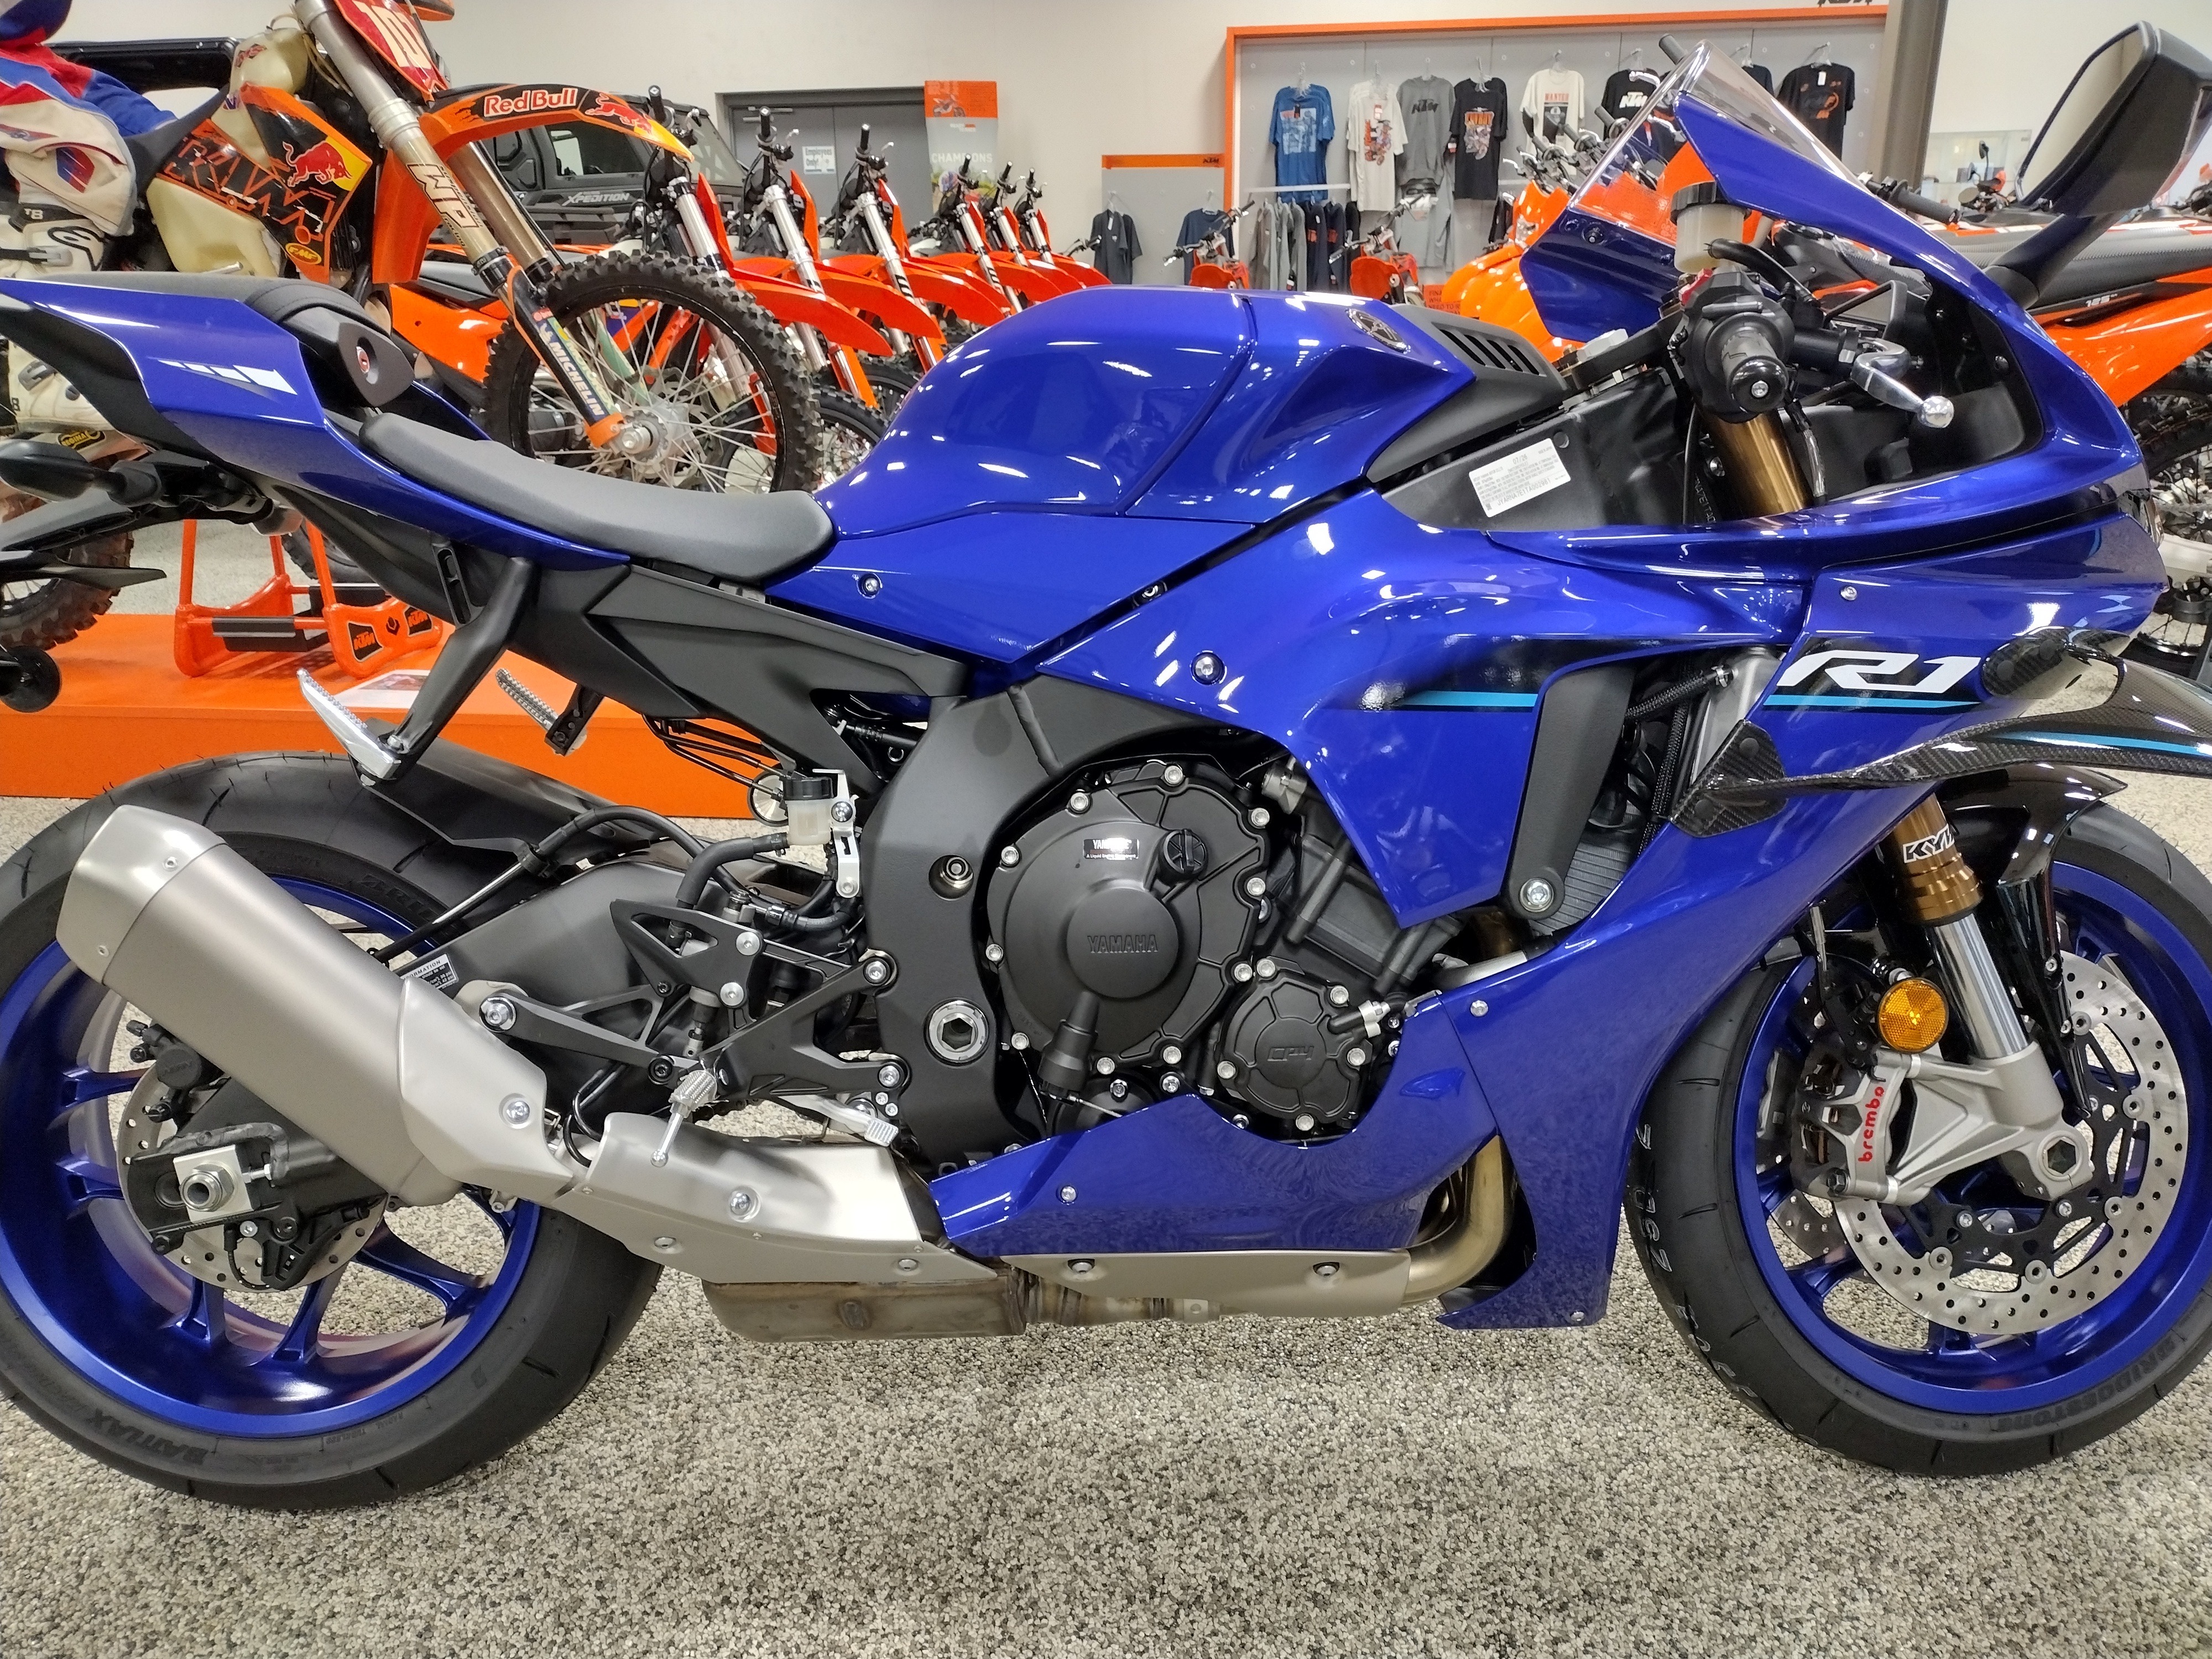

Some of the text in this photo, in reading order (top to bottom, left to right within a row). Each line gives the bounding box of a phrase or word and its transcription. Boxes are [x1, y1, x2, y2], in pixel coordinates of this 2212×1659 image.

[484, 87, 578, 117] Red Bull
[1411, 98, 1439, 114] KTM
[1619, 91, 1648, 108] KTM
[406, 164, 480, 229] WP
[561, 191, 630, 206] XPEDITION
[444, 218, 466, 247] racing
[287, 247, 319, 262] FMF
[549, 341, 605, 416] MICHELIN
[408, 610, 429, 628] KTM
[353, 630, 376, 650] KTM
[1776, 649, 1981, 693] R1
[1087, 934, 1158, 954] YAMAHA
[1858, 1081, 1885, 1162] brembo
[1997, 1339, 2176, 1432] BRIDGESTONE
